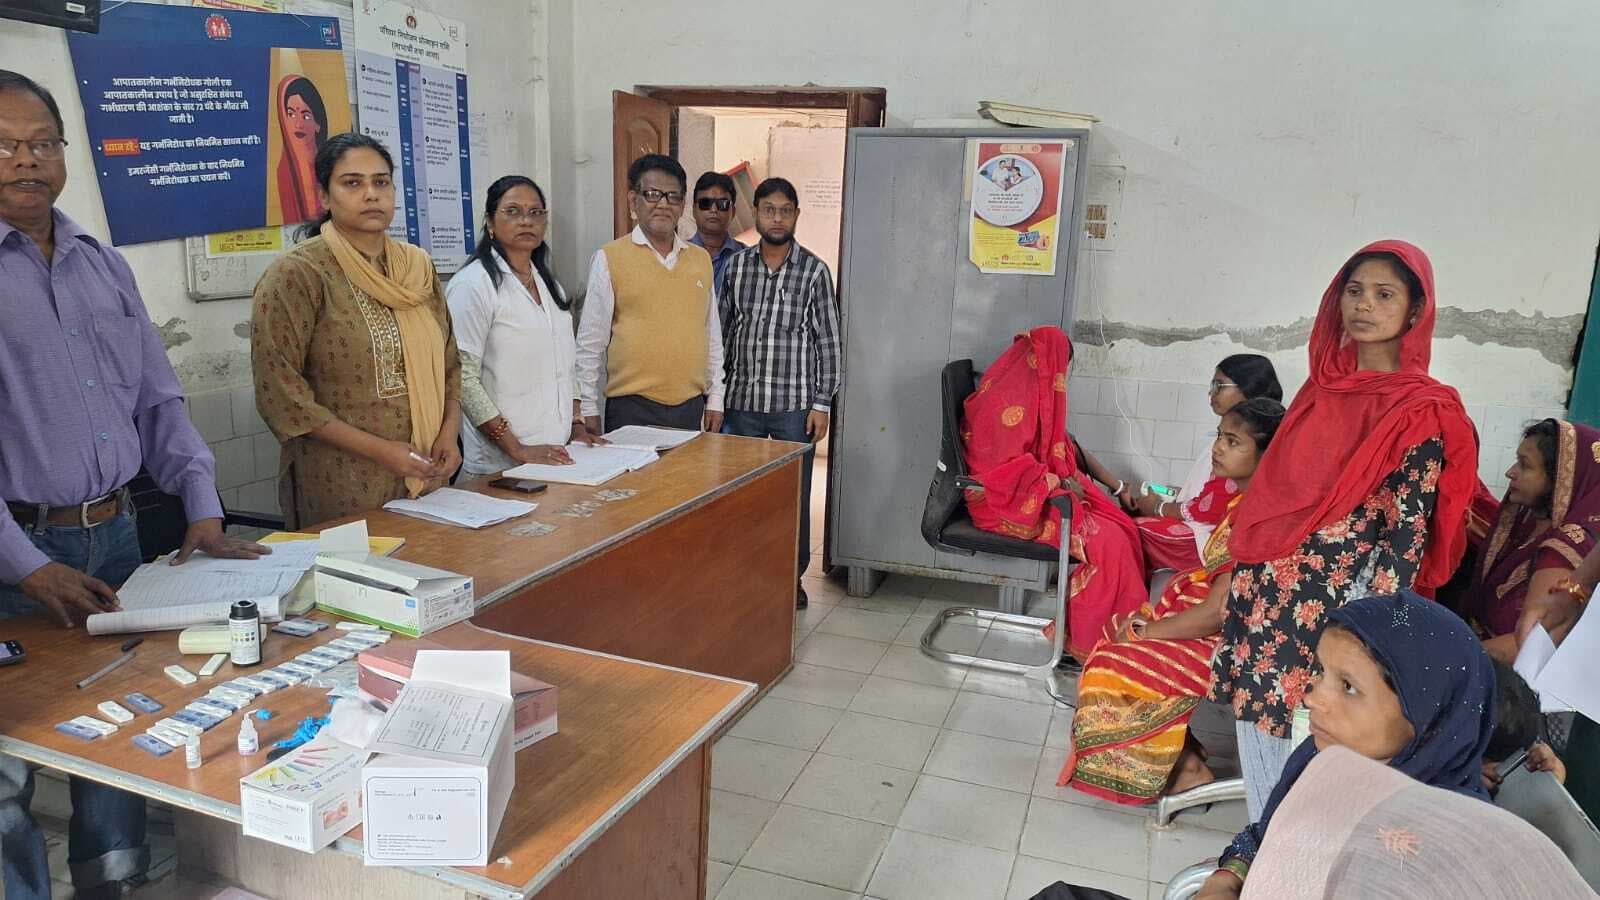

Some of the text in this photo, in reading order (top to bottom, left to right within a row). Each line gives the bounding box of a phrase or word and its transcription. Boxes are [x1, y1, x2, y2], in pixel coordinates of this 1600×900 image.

[112, 76, 161, 86] आपातकालीन
[203, 76, 220, 86] गोली
[220, 78, 232, 86] एक
[104, 89, 153, 99] आपातकालीन
[154, 91, 172, 99] उपाय
[173, 88, 178, 99] है
[180, 88, 188, 98] जो
[135, 101, 147, 111] की
[195, 103, 203, 111] 72
[168, 113, 186, 123] जाती
[140, 142, 151, 150] यह
